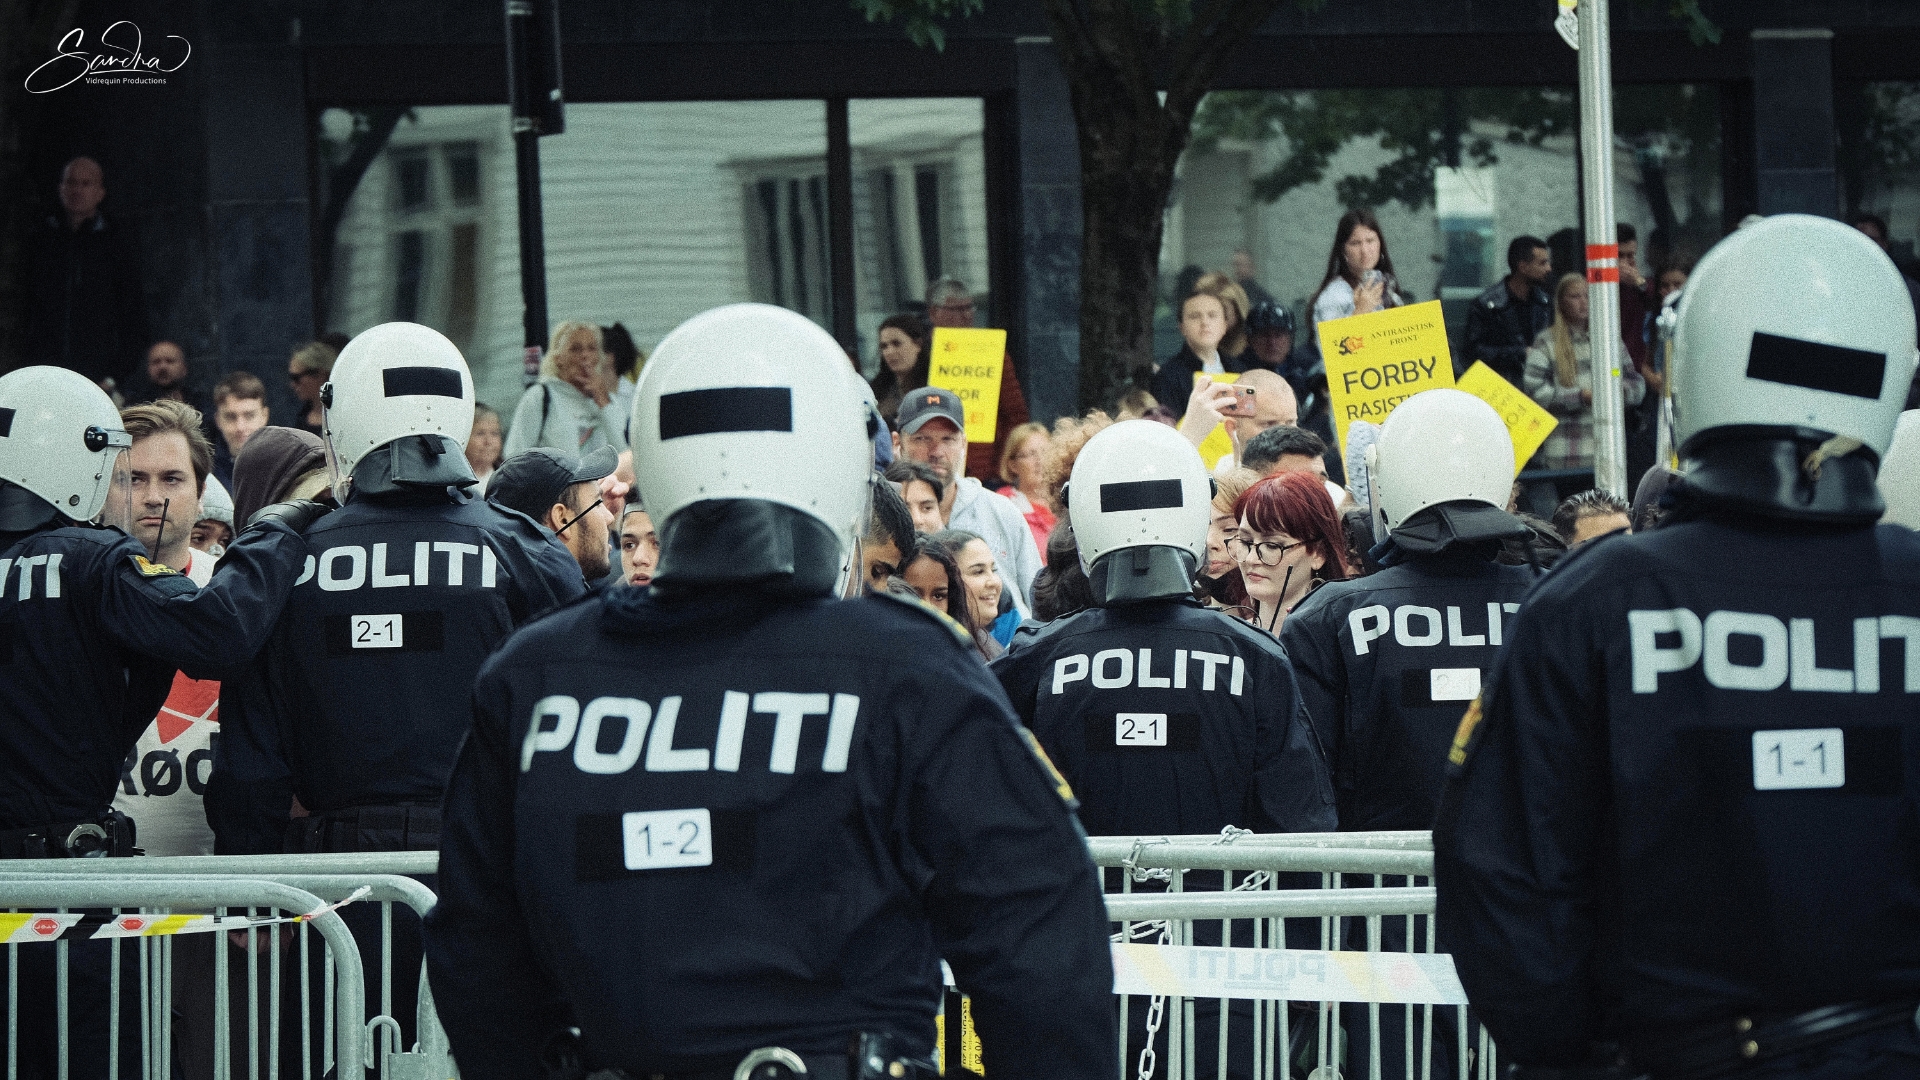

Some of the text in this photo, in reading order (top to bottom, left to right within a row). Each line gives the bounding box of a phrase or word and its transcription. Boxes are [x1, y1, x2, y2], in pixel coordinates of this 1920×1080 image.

[1371, 322, 1434, 340] ANTIRASISTISK
[1389, 334, 1419, 346] FRONT
[939, 365, 996, 378] NORGE
[1343, 356, 1437, 394] FORBY
[950, 388, 980, 400] OR
[1346, 393, 1418, 420] RASIST
[357, 620, 394, 642] 2-1
[1052, 648, 1245, 696] POLITI
[520, 690, 861, 775] POLITI
[1121, 718, 1158, 740] 2-1
[1769, 741, 1826, 776] 1-1
[638, 820, 701, 857] 1-2
